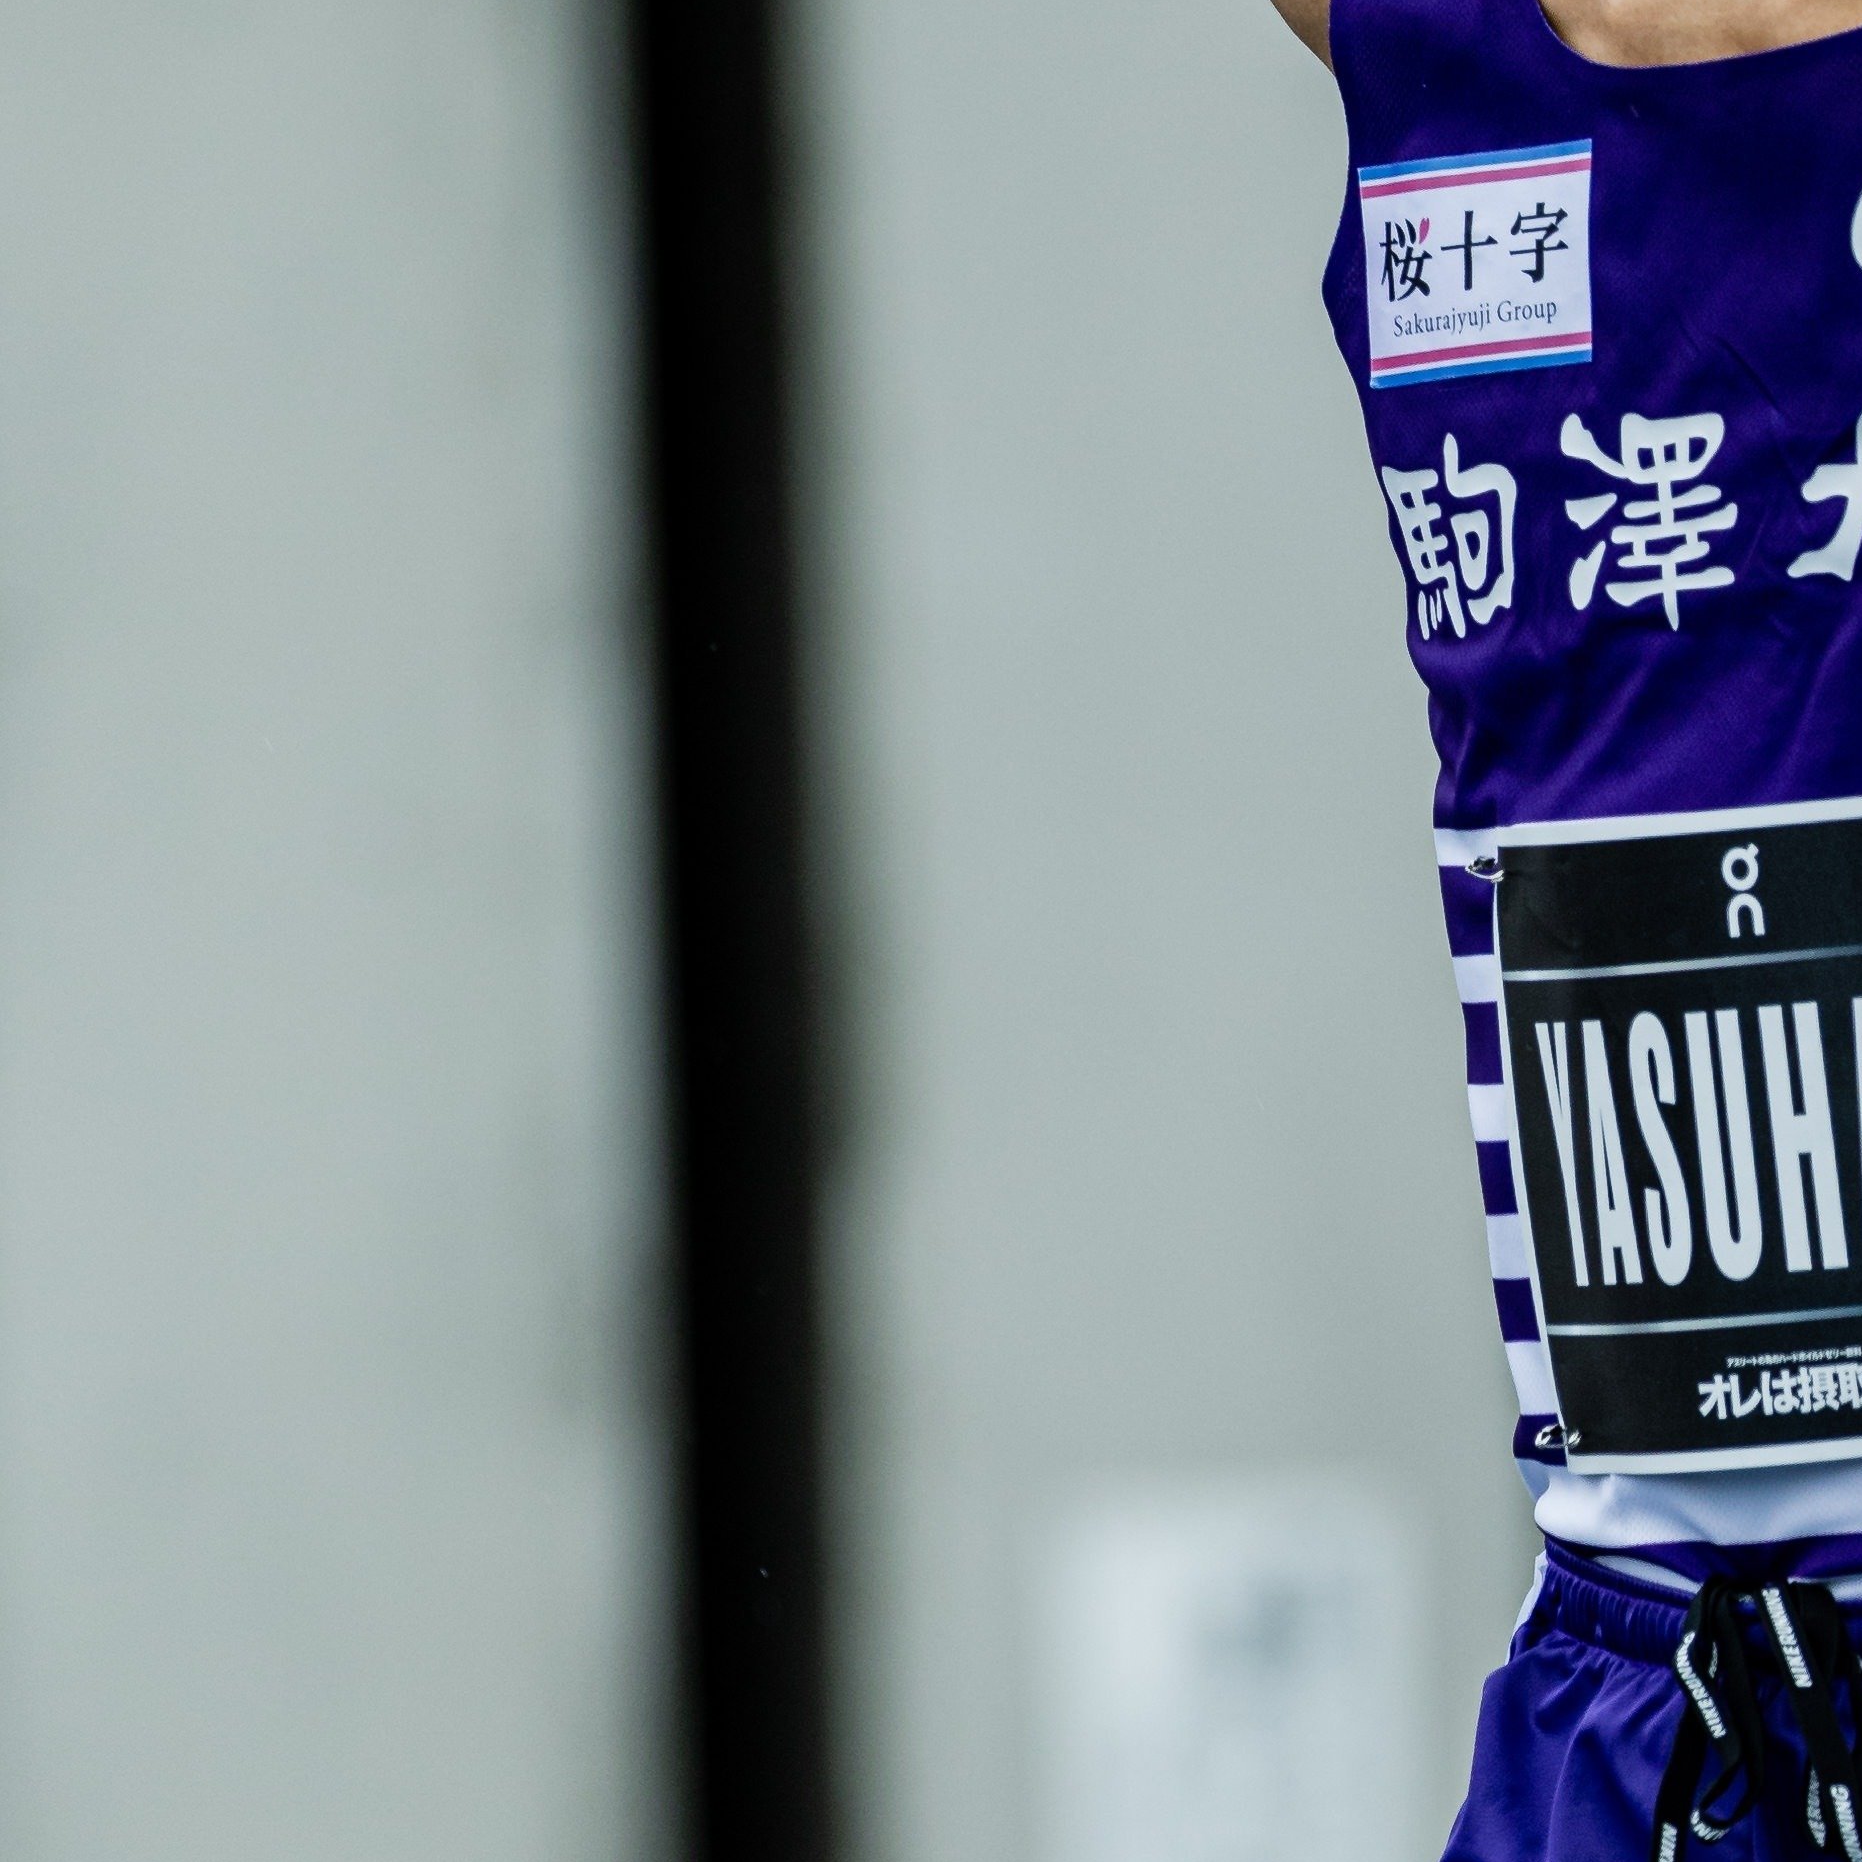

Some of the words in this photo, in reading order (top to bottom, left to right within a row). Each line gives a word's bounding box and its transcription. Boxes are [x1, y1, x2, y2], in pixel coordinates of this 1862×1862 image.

[1378, 201, 1570, 304] 桜十字
[1392, 303, 1491, 338] Sakurajyuji
[1496, 299, 1558, 325] Group
